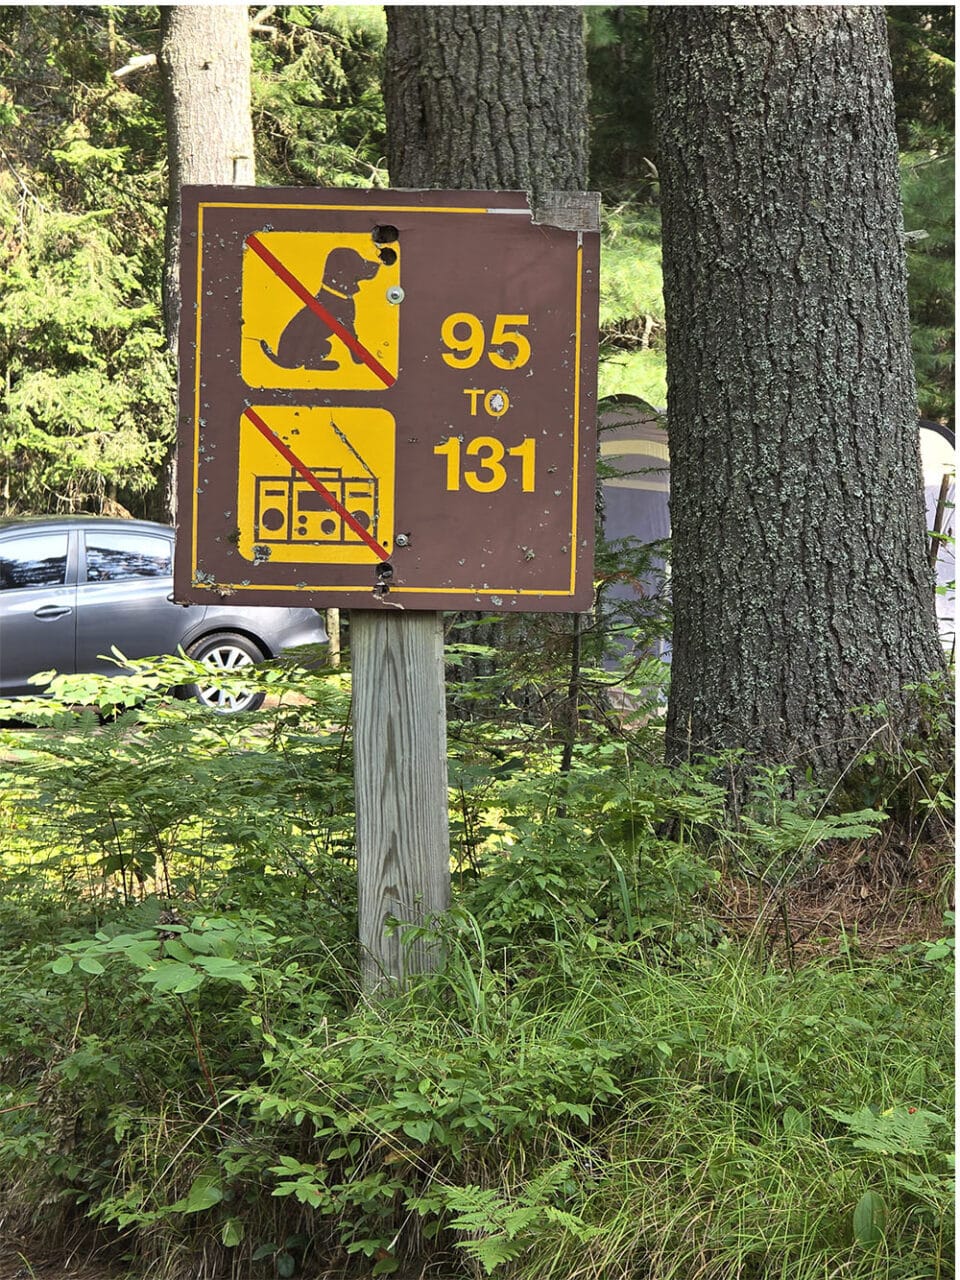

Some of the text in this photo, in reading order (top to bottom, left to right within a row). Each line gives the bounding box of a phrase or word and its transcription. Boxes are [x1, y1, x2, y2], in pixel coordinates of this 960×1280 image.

[440, 312, 532, 371] 95
[463, 389, 510, 416] TO
[433, 436, 536, 494] 131
